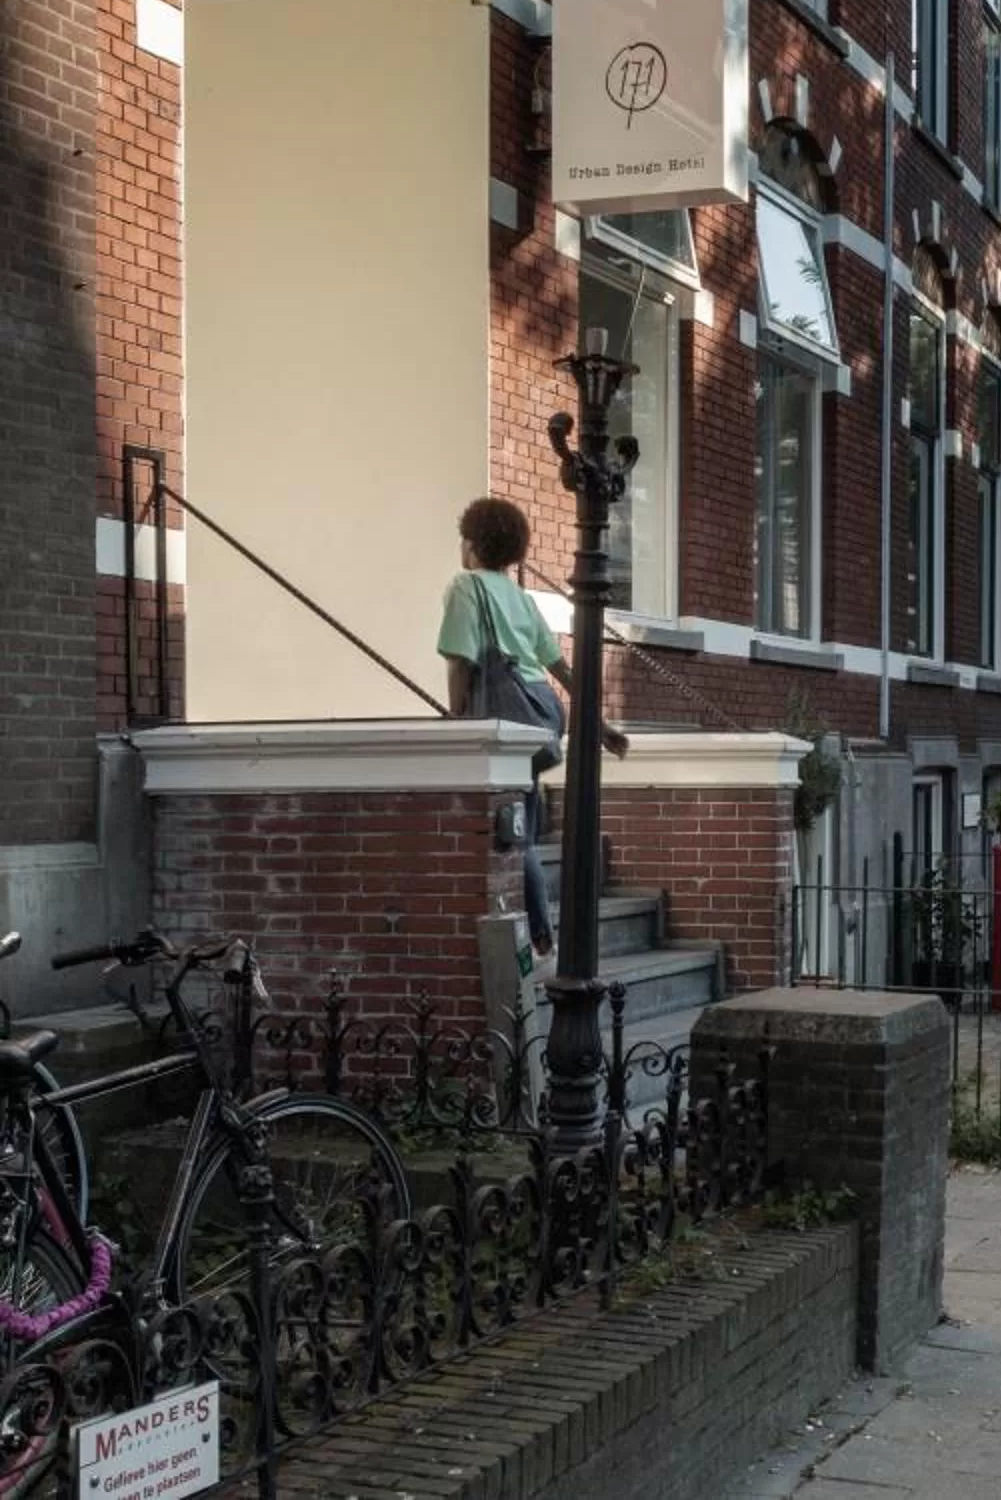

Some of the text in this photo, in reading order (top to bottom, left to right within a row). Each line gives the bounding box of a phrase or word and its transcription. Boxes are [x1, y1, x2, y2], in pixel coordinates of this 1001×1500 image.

[568, 157, 704, 179] Urban Design Hotel
[96, 1395, 209, 1460] MANDERS
[104, 1448, 196, 1492] Gelieve hier geen
[144, 1486, 154, 1498] te
[156, 1468, 200, 1497] plaatsen
